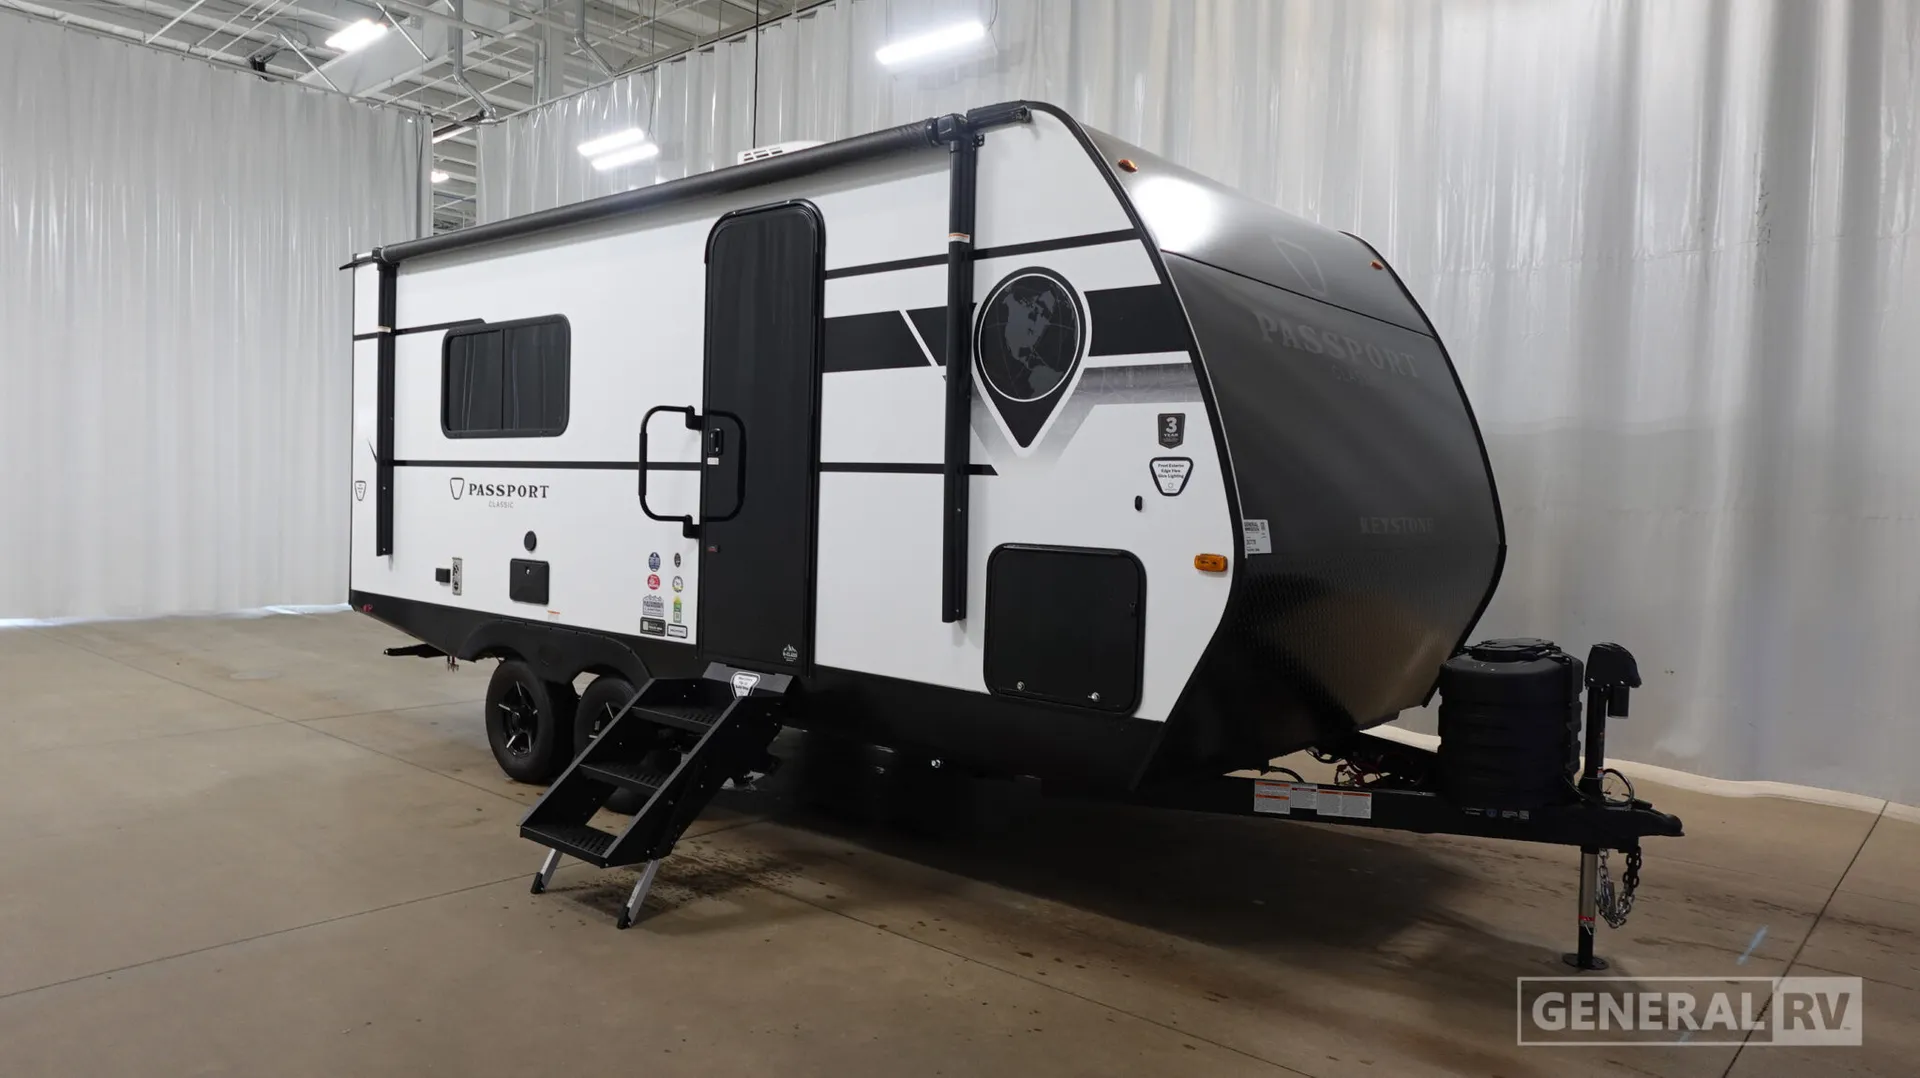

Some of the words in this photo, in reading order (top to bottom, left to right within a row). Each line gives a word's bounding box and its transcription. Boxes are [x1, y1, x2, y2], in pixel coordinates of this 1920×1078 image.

[1252, 310, 1418, 377] PASSPORT
[1165, 416, 1178, 434] 3
[468, 483, 550, 499] PASSPORT
[488, 500, 514, 509] CLASSIC
[1359, 516, 1434, 534] KEYSTONE
